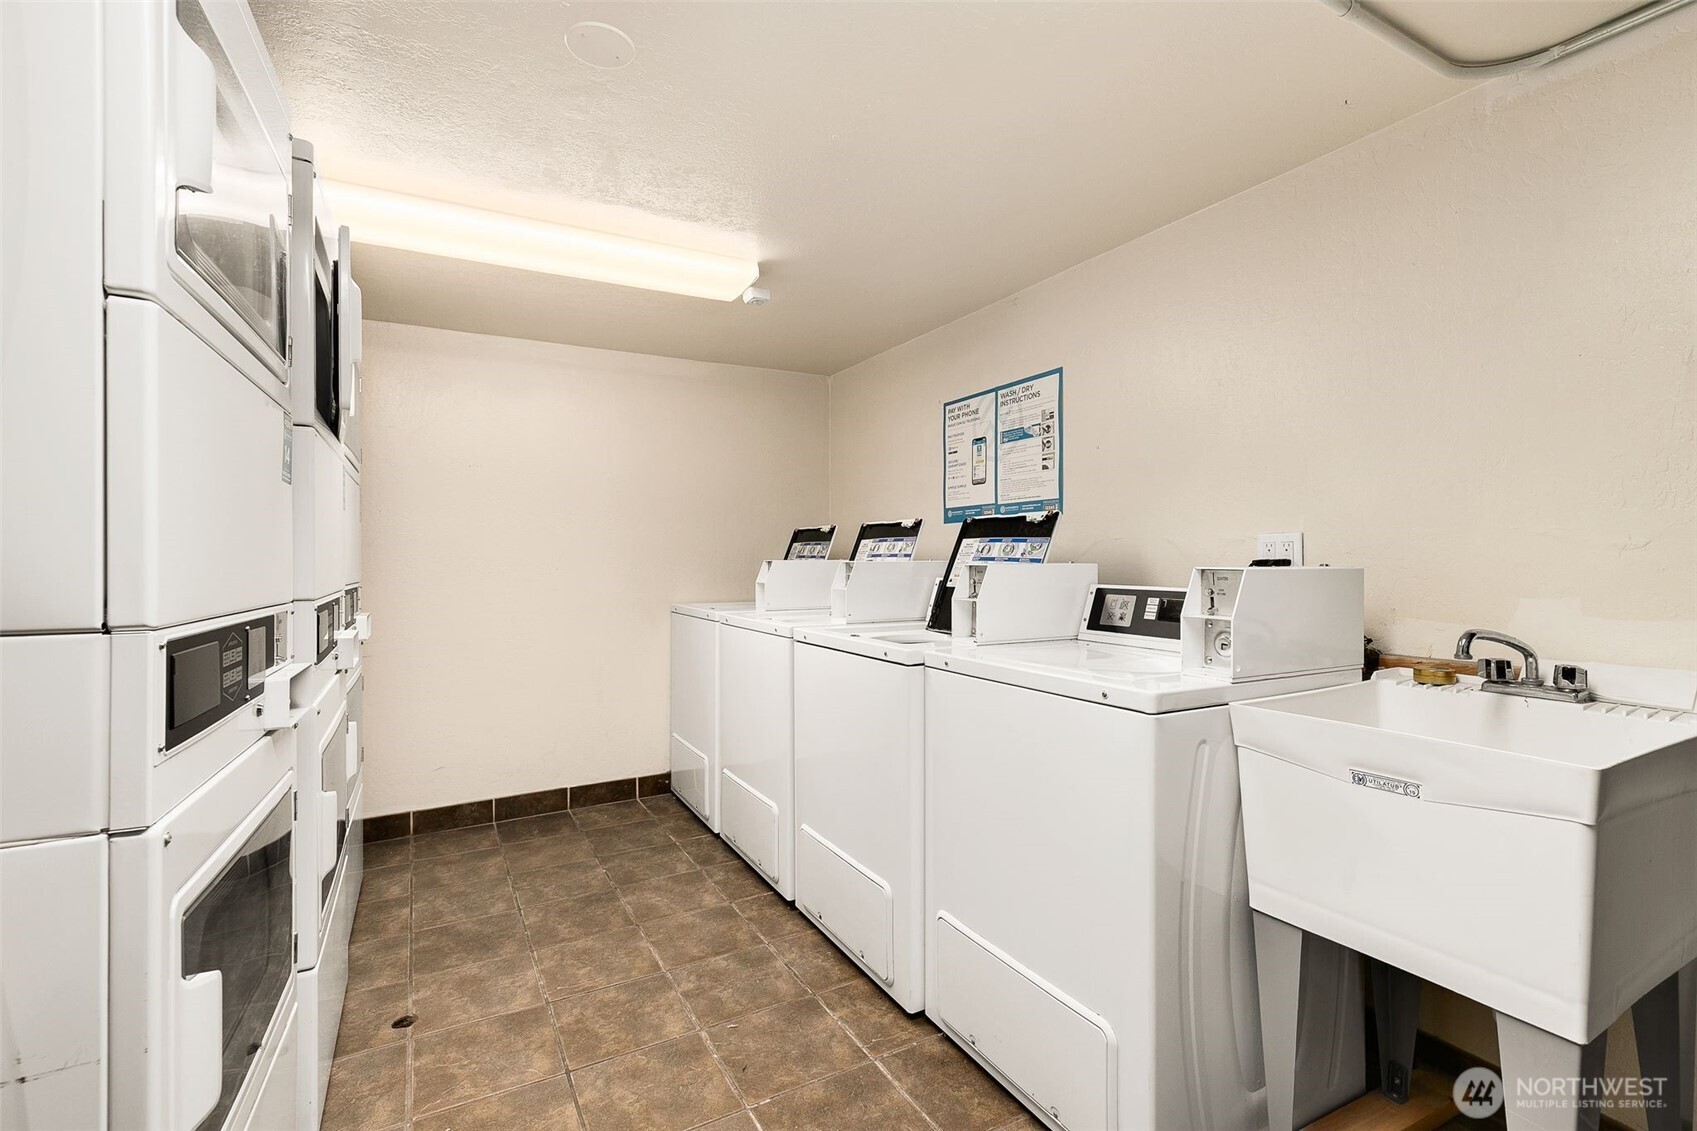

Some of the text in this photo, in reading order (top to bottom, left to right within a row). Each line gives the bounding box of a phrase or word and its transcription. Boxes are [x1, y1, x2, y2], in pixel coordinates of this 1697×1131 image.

[1000, 389, 1017, 400] WASH
[1021, 384, 1034, 394] DRY
[1000, 390, 1041, 407] INSTRUCTIONS
[947, 403, 971, 415] PAY WITH
[947, 408, 980, 422] YOUR PHONE
